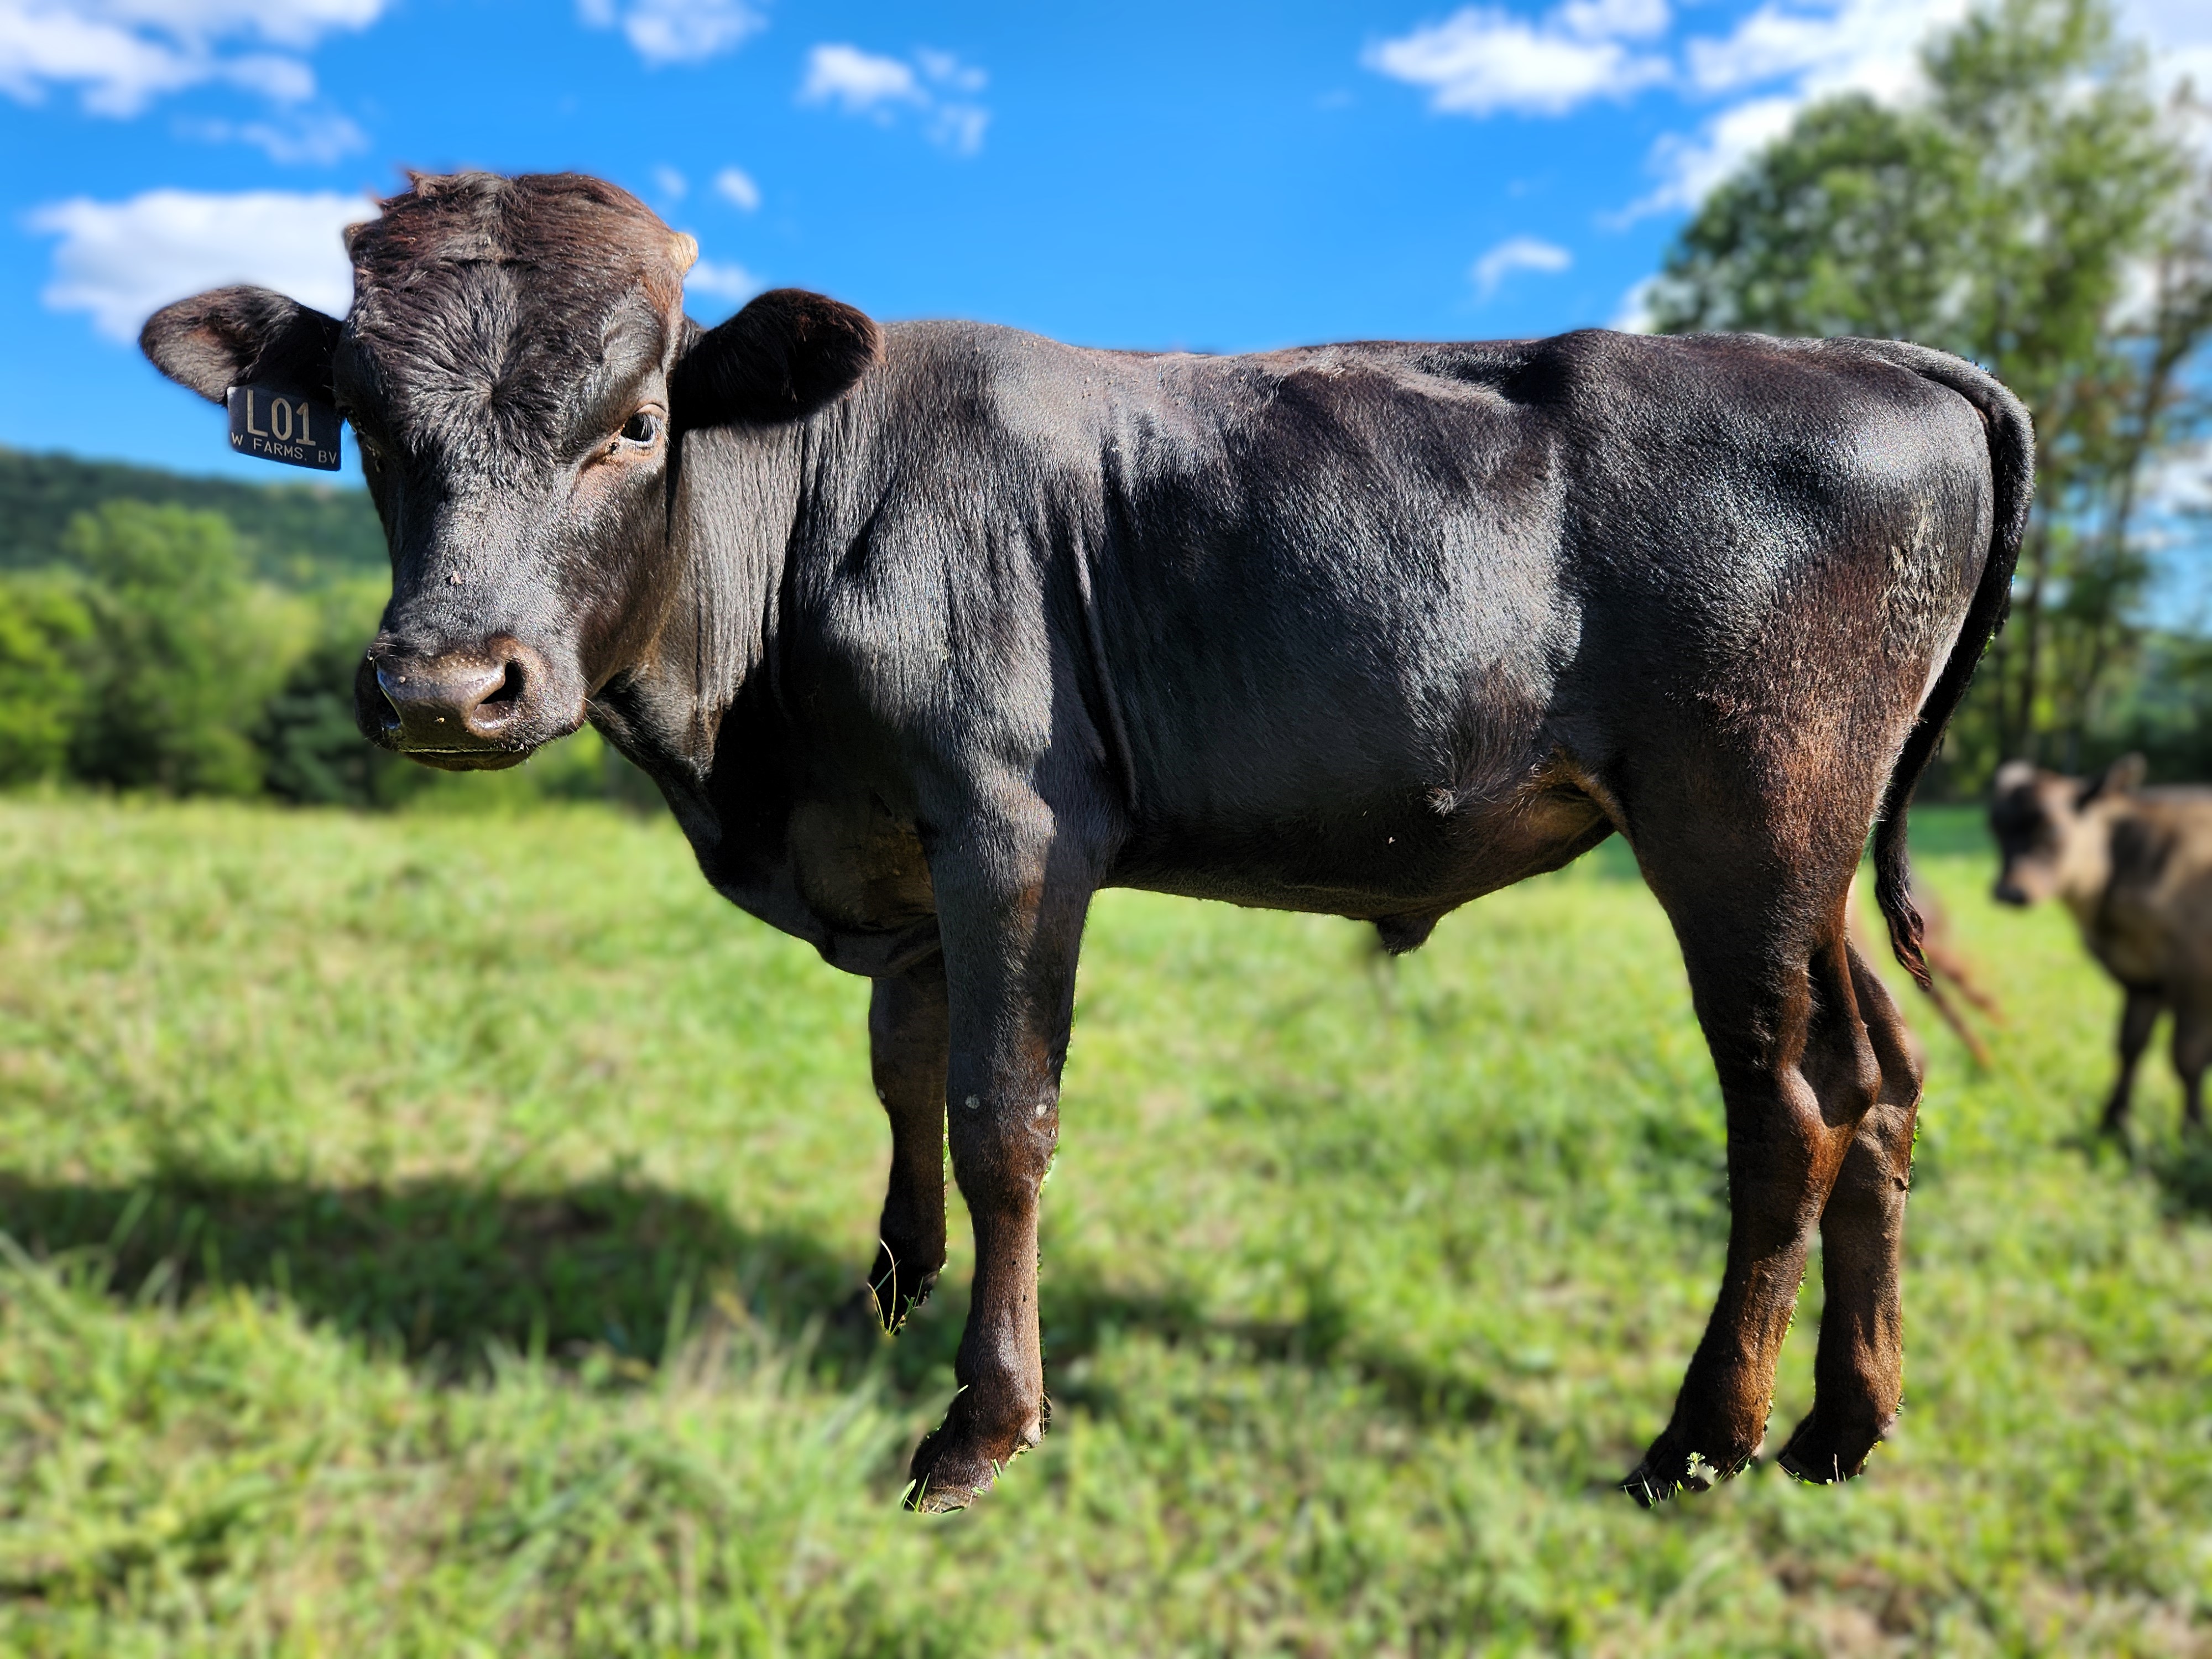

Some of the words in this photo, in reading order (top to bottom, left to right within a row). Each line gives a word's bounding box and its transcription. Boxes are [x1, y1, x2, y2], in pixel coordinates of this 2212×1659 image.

[247, 390, 316, 446] L01
[232, 432, 243, 446] W
[318, 450, 337, 464] BV
